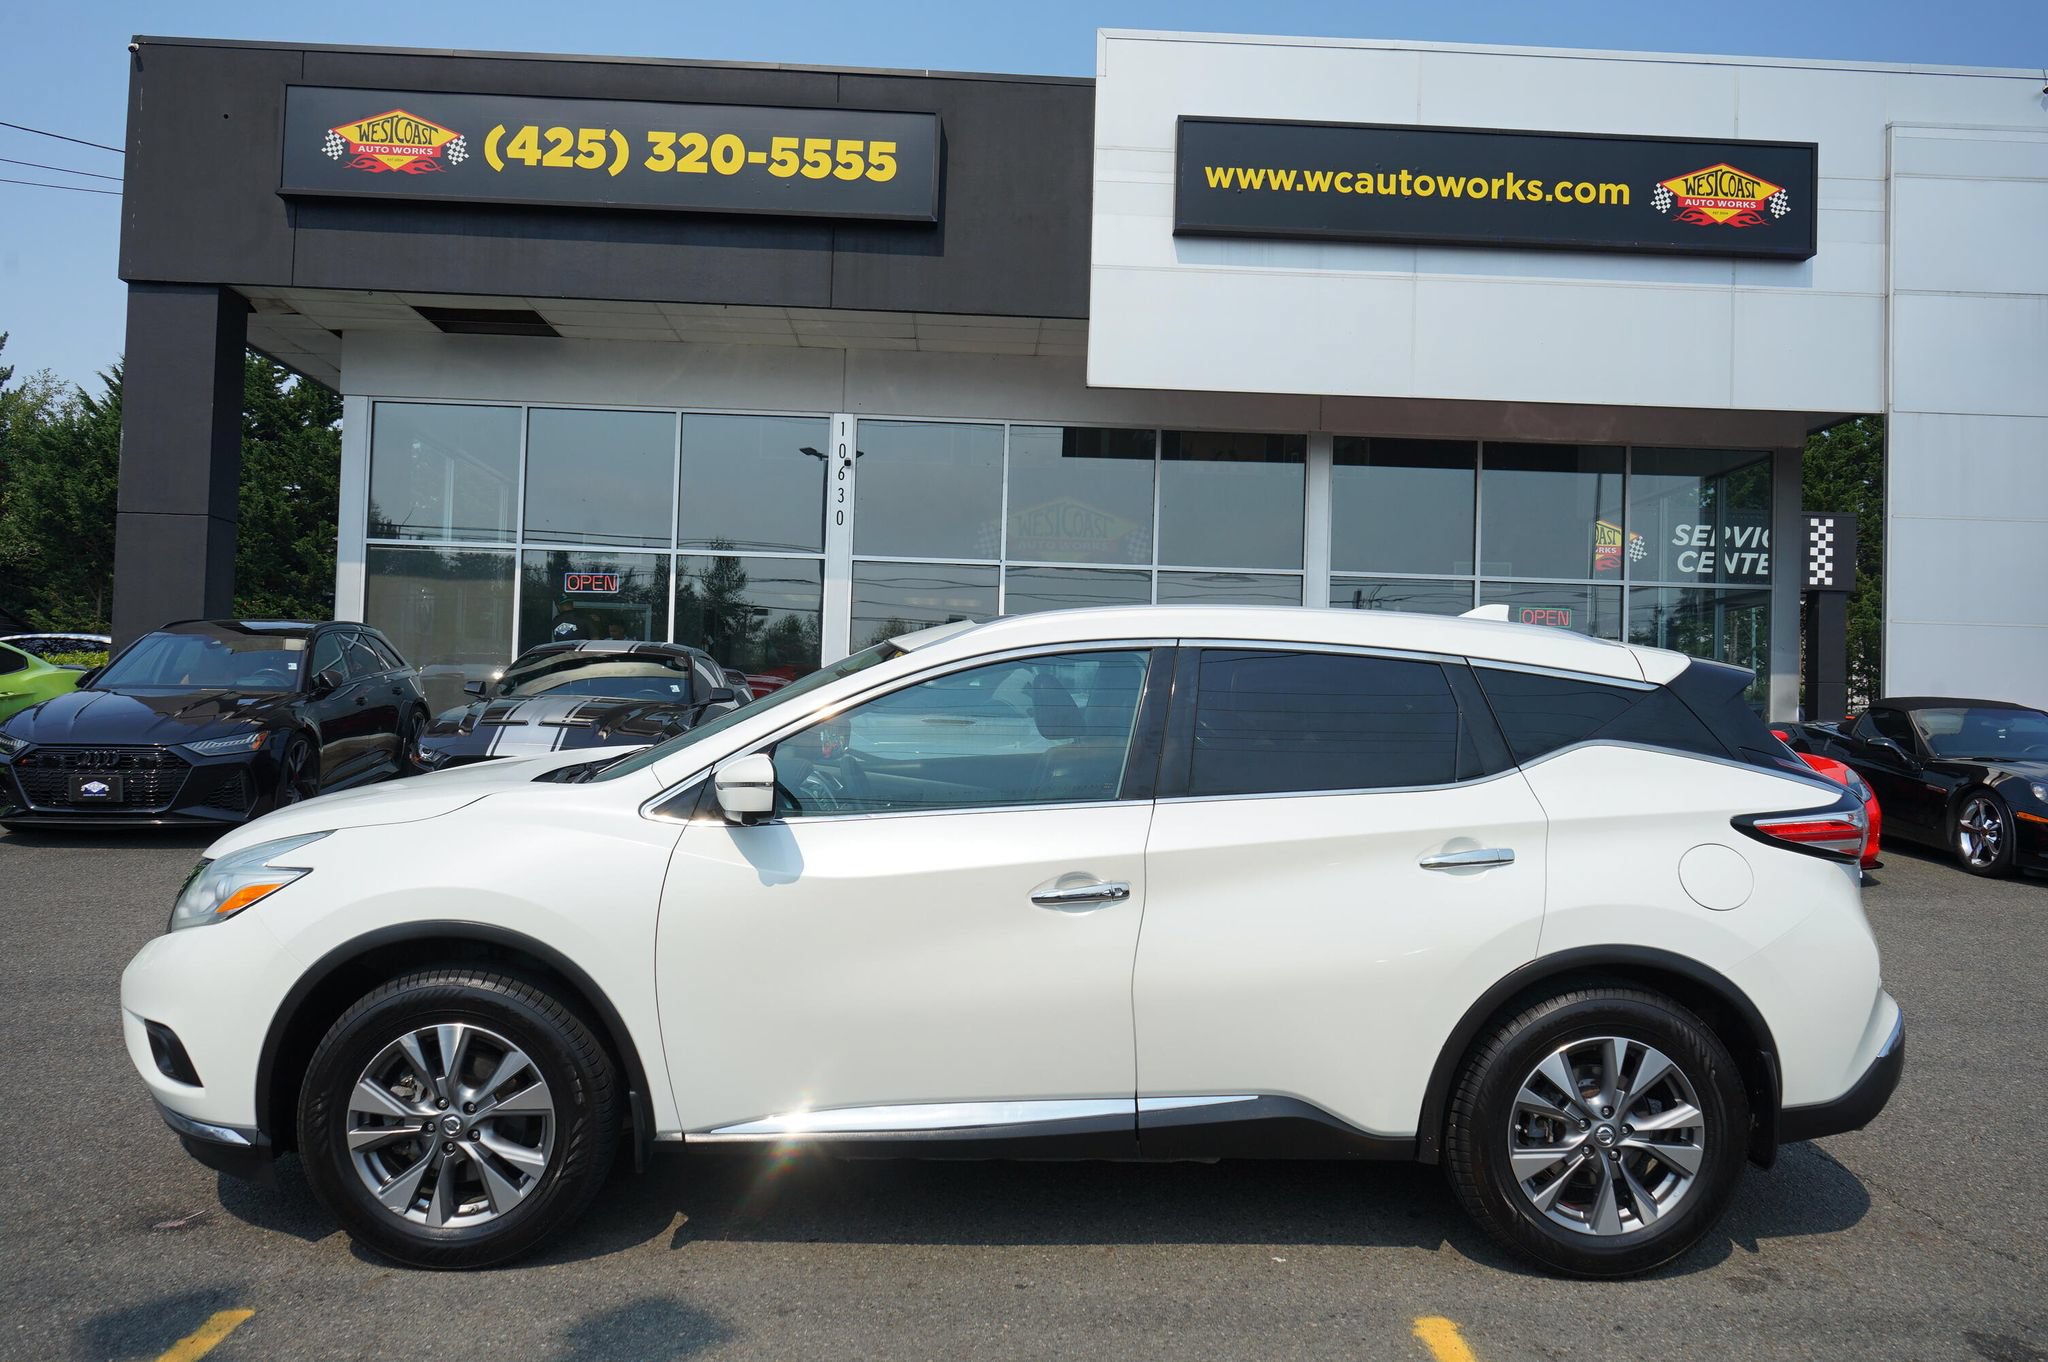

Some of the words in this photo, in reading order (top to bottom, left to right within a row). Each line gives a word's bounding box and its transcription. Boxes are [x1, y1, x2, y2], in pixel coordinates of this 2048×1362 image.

[358, 145, 390, 154] AUTO
[396, 146, 433, 155] WORKS
[484, 124, 630, 177] (425)
[644, 131, 897, 182] 320-5555
[1204, 166, 1630, 205] www.wcautoworks.com
[1685, 198, 1715, 207] AUTO
[1717, 199, 1757, 209] WORKS
[836, 421, 847, 526] 10630
[567, 575, 617, 591] OPEN
[1522, 609, 1569, 626] OPEN
